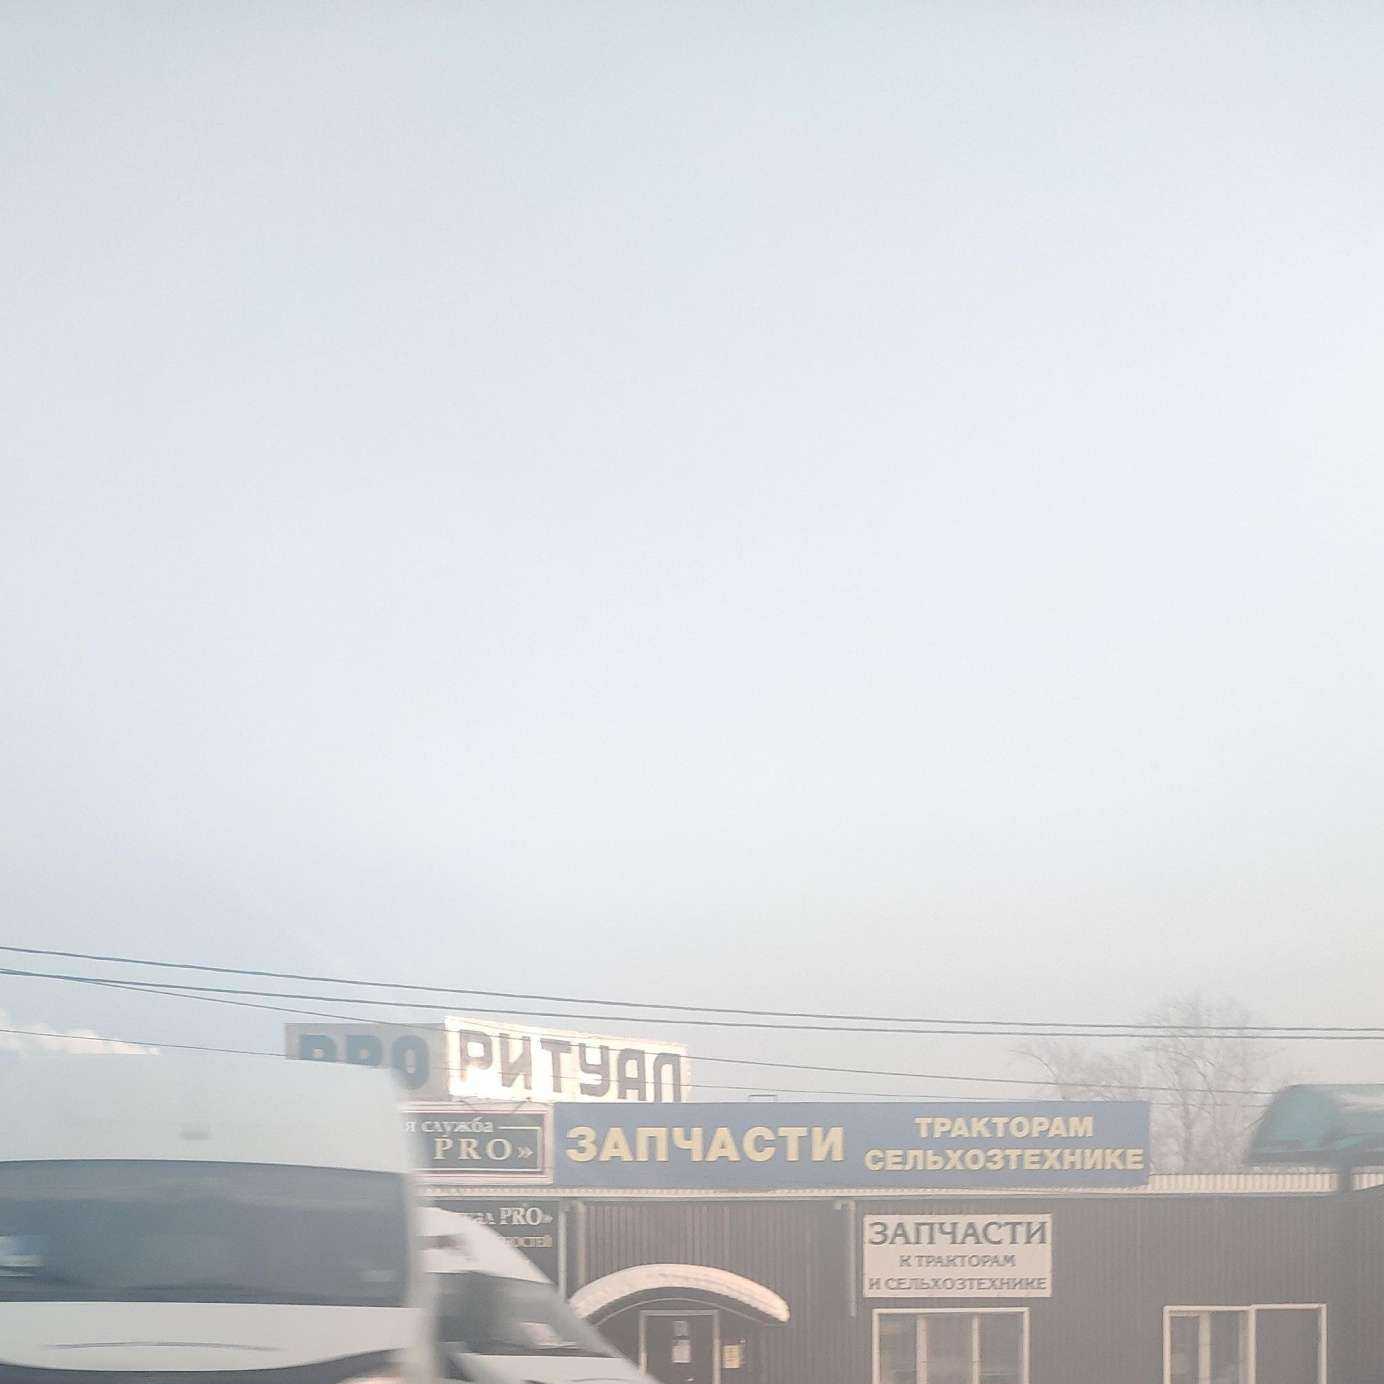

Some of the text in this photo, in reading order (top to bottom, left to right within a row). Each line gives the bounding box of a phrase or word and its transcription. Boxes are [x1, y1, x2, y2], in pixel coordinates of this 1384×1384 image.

[458, 1028, 683, 1103] РИТУАЛ
[420, 1116, 495, 1137] служба
[913, 1116, 1094, 1138] ТРАКТОРАМ
[565, 1126, 845, 1162] ЗАПЧАСТИ
[863, 1149, 1145, 1171] СЕЛЬХОЗТЕХНИКЕ
[868, 1221, 1048, 1246] ЗАПЧАСТИ
[899, 1255, 1016, 1268] К ТРАКТОРАМ
[868, 1277, 1047, 1291] И СЕЛЬХОЗТЕХНИКЕ
